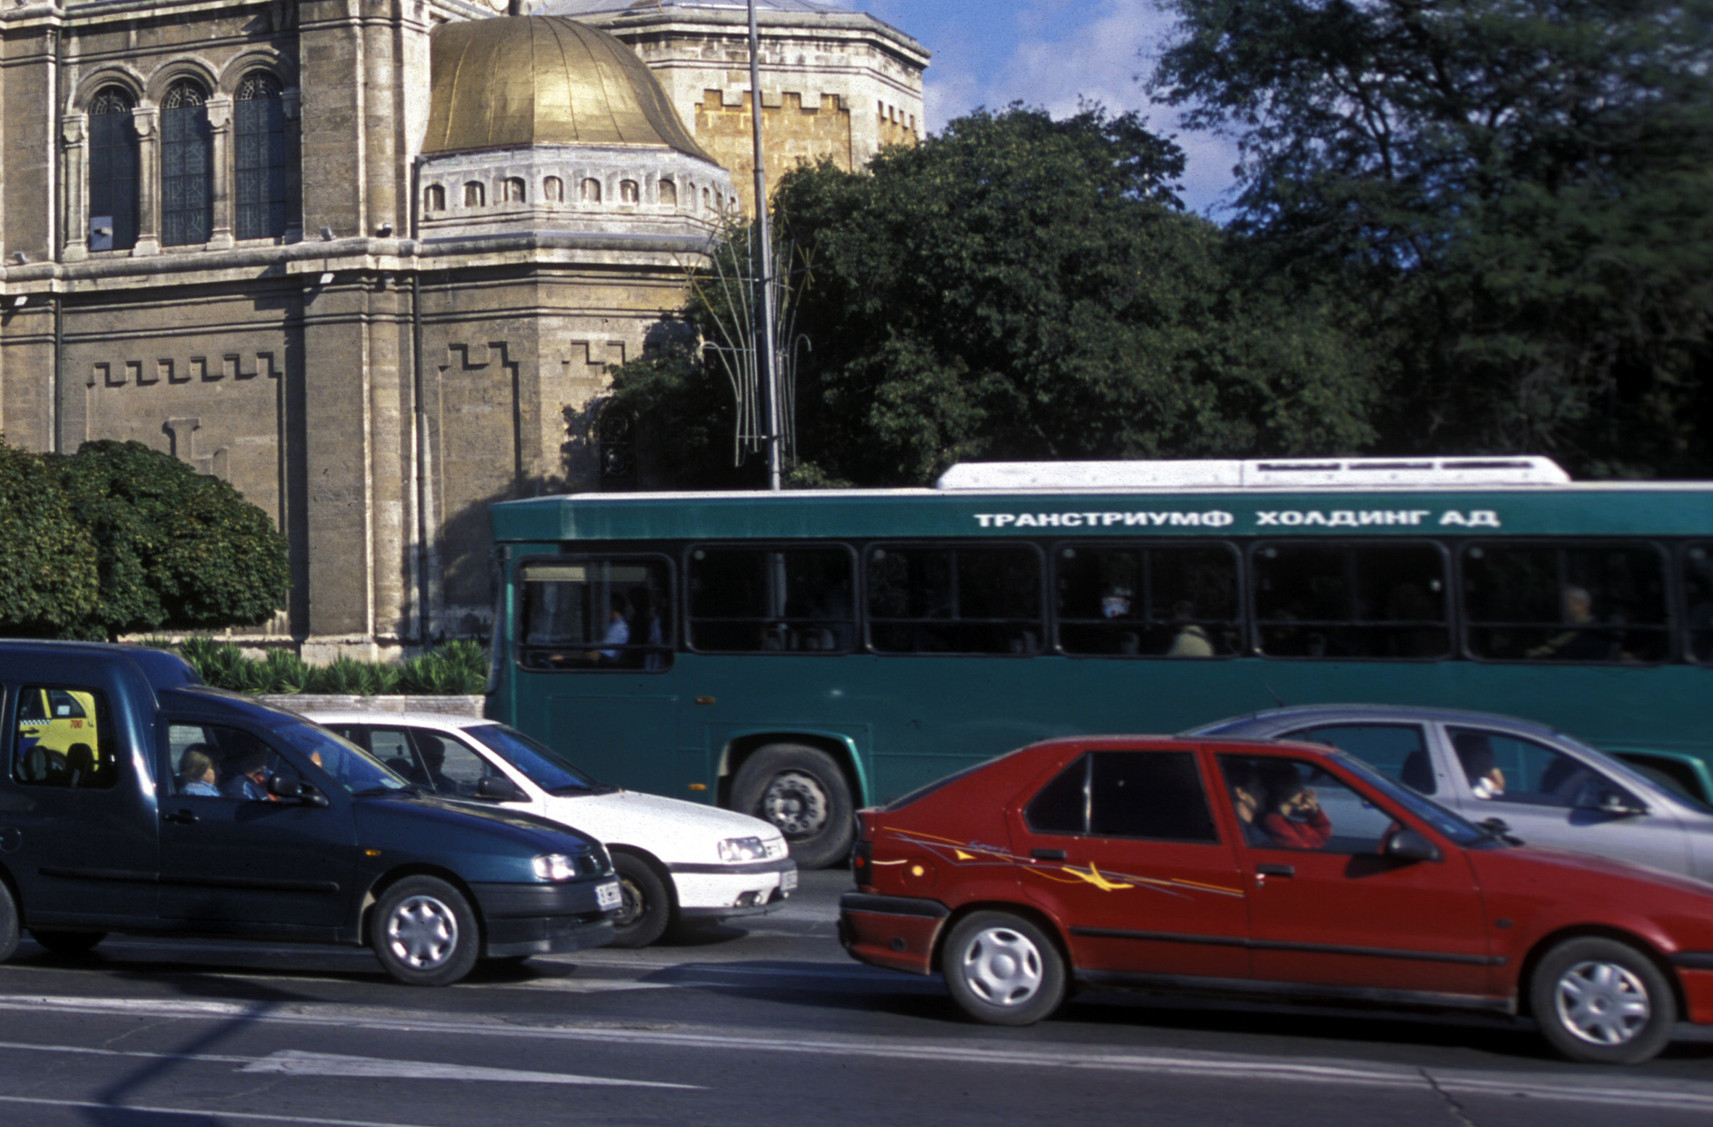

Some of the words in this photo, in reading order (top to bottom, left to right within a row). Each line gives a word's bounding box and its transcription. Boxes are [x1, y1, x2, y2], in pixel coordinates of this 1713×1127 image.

[973, 510, 1234, 528] ТРАНСТРИУМФ
[1255, 509, 1431, 527] ХОЛДИНГ
[1439, 509, 1501, 527] АД
